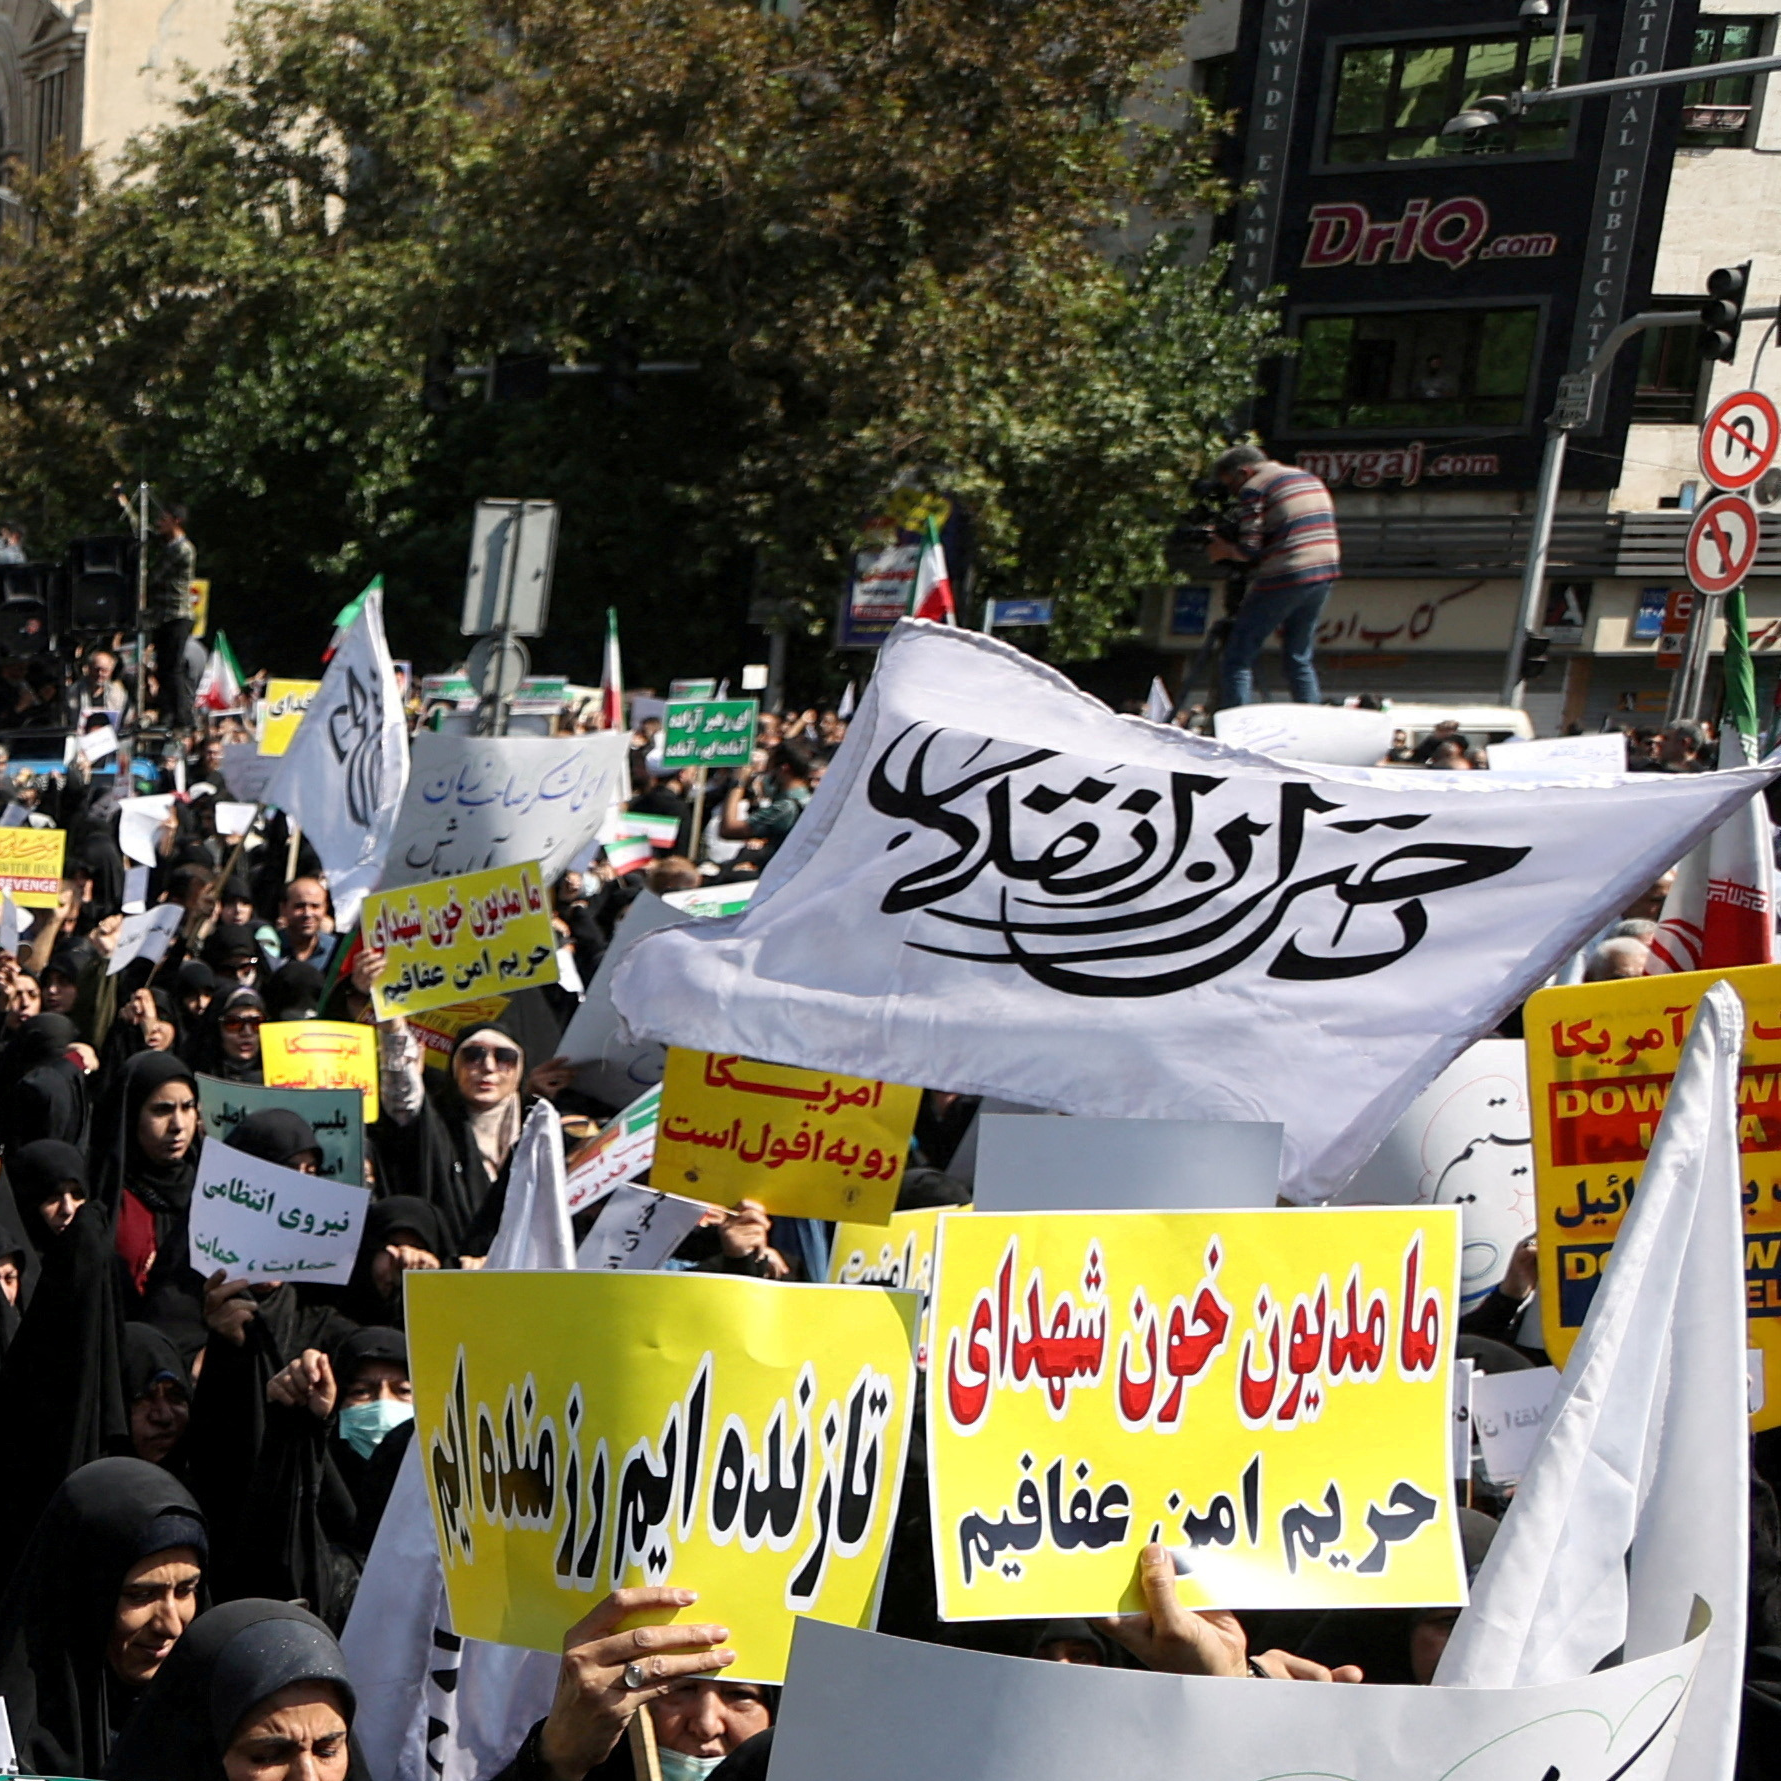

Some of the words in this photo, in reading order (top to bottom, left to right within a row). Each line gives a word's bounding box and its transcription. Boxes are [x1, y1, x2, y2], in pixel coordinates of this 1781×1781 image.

[1301, 197, 1558, 268] DriQ.com
[426, 886, 464, 948] خون
[468, 884, 523, 941] مدیون
[520, 869, 544, 918] ما
[452, 947, 493, 989] امن
[498, 943, 552, 982] حریم
[1550, 1005, 1693, 1066] آمریکا
[661, 1115, 740, 1152] است
[738, 1120, 825, 1170] افول
[827, 1136, 861, 1178] به
[868, 1144, 900, 1182] رو
[201, 1176, 276, 1216] انتظامی
[276, 1208, 351, 1237] نیروی
[948, 1245, 1107, 1427] شهدای
[1118, 1243, 1230, 1424] خون
[1400, 1238, 1439, 1376] ما
[1238, 1272, 1387, 1422] مدیون
[958, 1452, 1132, 1587] عفافیم
[1150, 1451, 1261, 1577] امن
[1281, 1480, 1438, 1576] حریم
